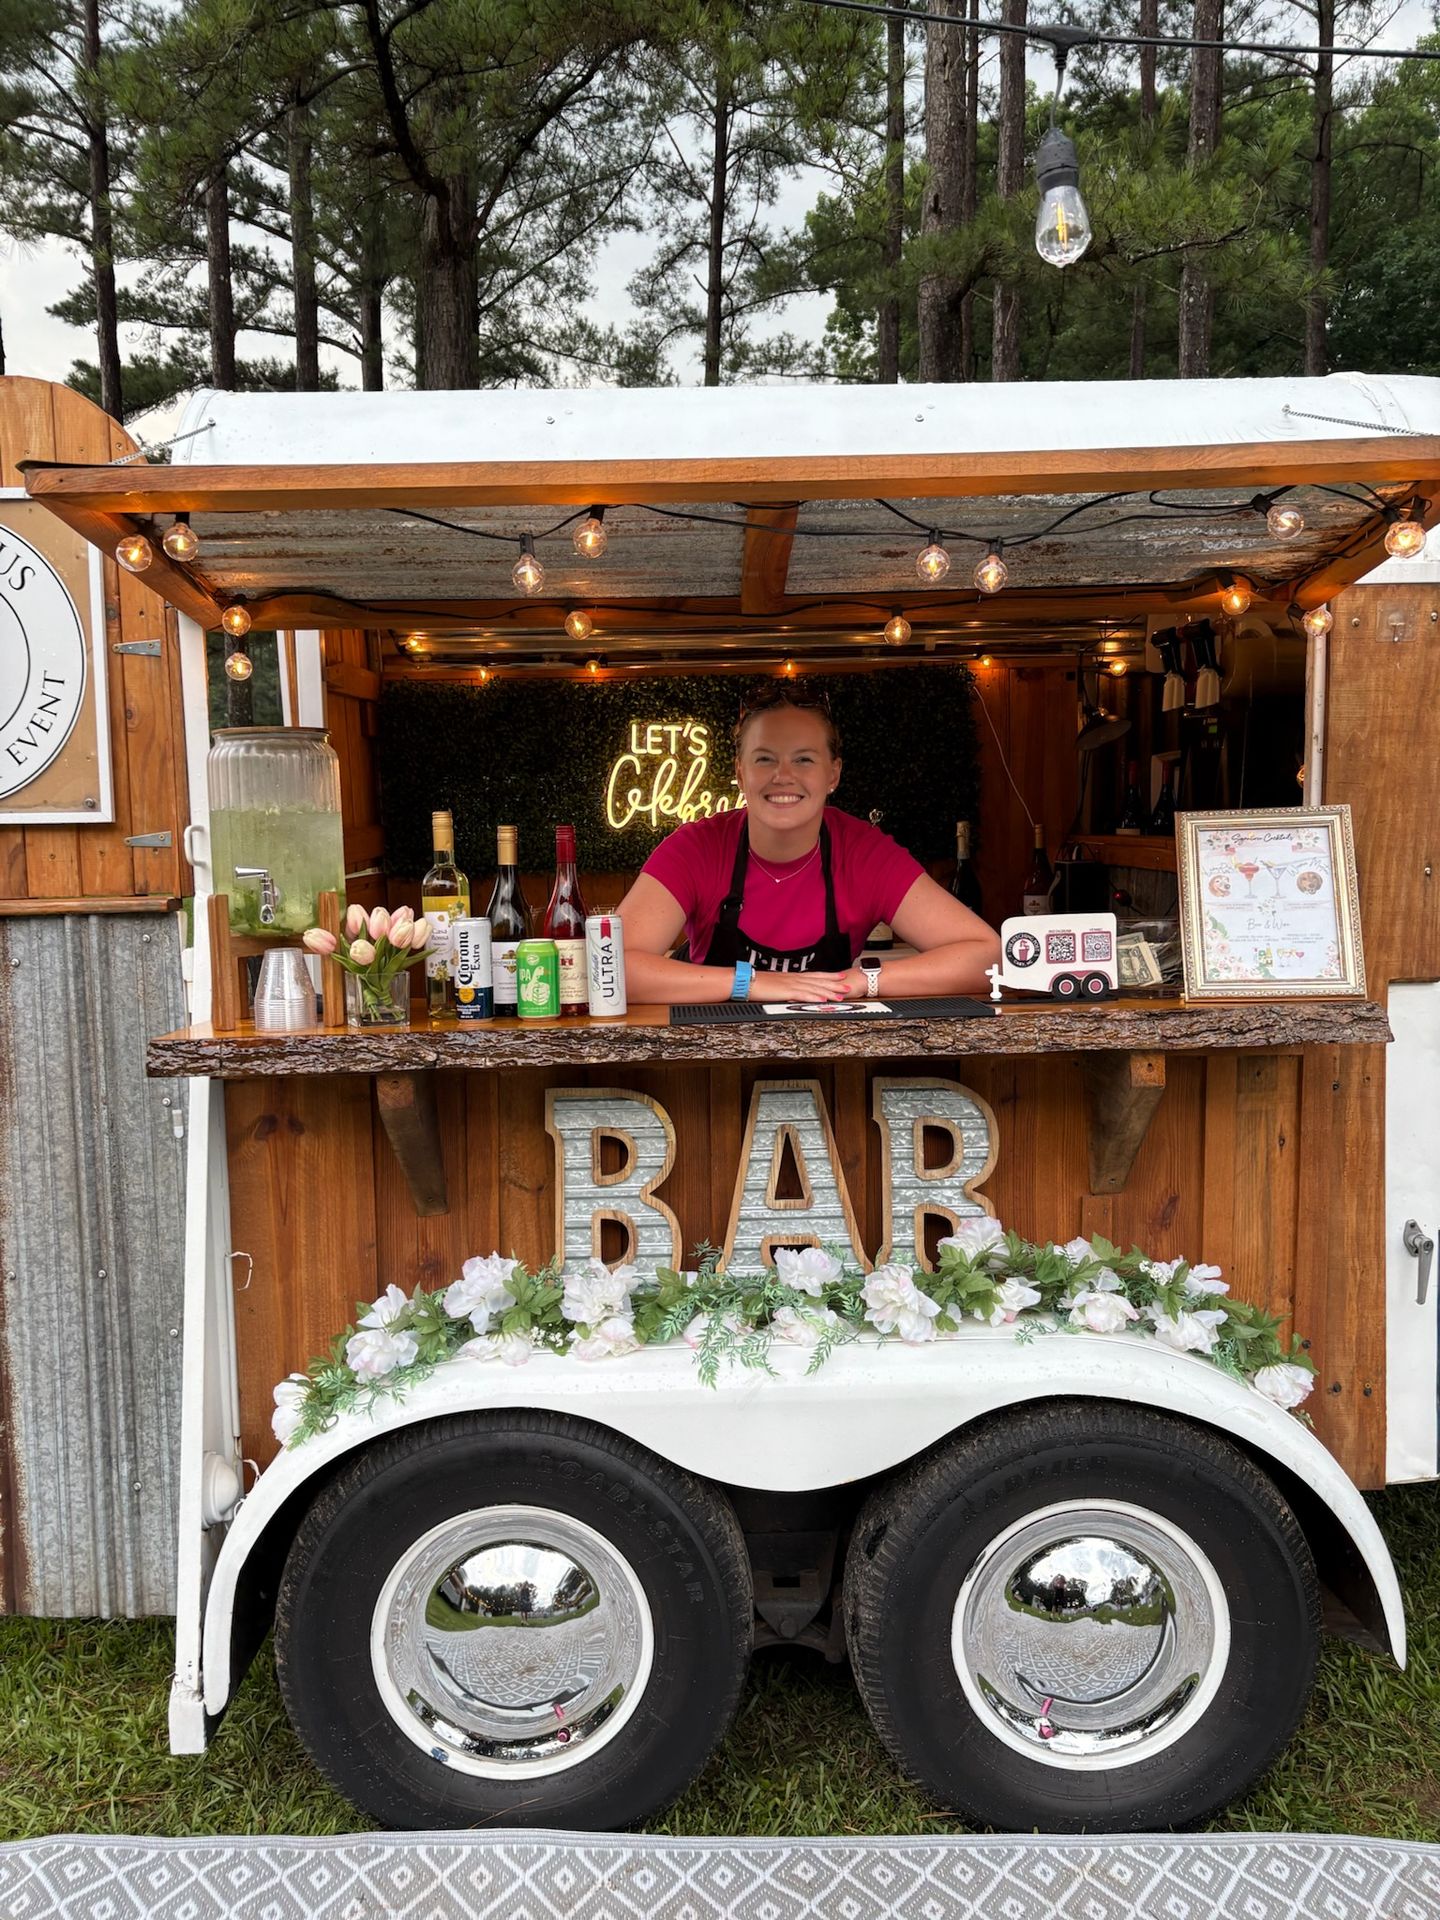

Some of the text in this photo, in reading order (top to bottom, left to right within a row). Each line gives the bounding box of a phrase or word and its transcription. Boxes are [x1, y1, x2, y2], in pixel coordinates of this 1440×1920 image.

[5, 670, 66, 767] EVENT
[631, 722, 708, 756] LET'S
[457, 931, 474, 985] Corona
[471, 944, 481, 971] Extra
[518, 968, 531, 982] IPA
[601, 943, 615, 998] ULTRA
[545, 1077, 1000, 1275] BAR
